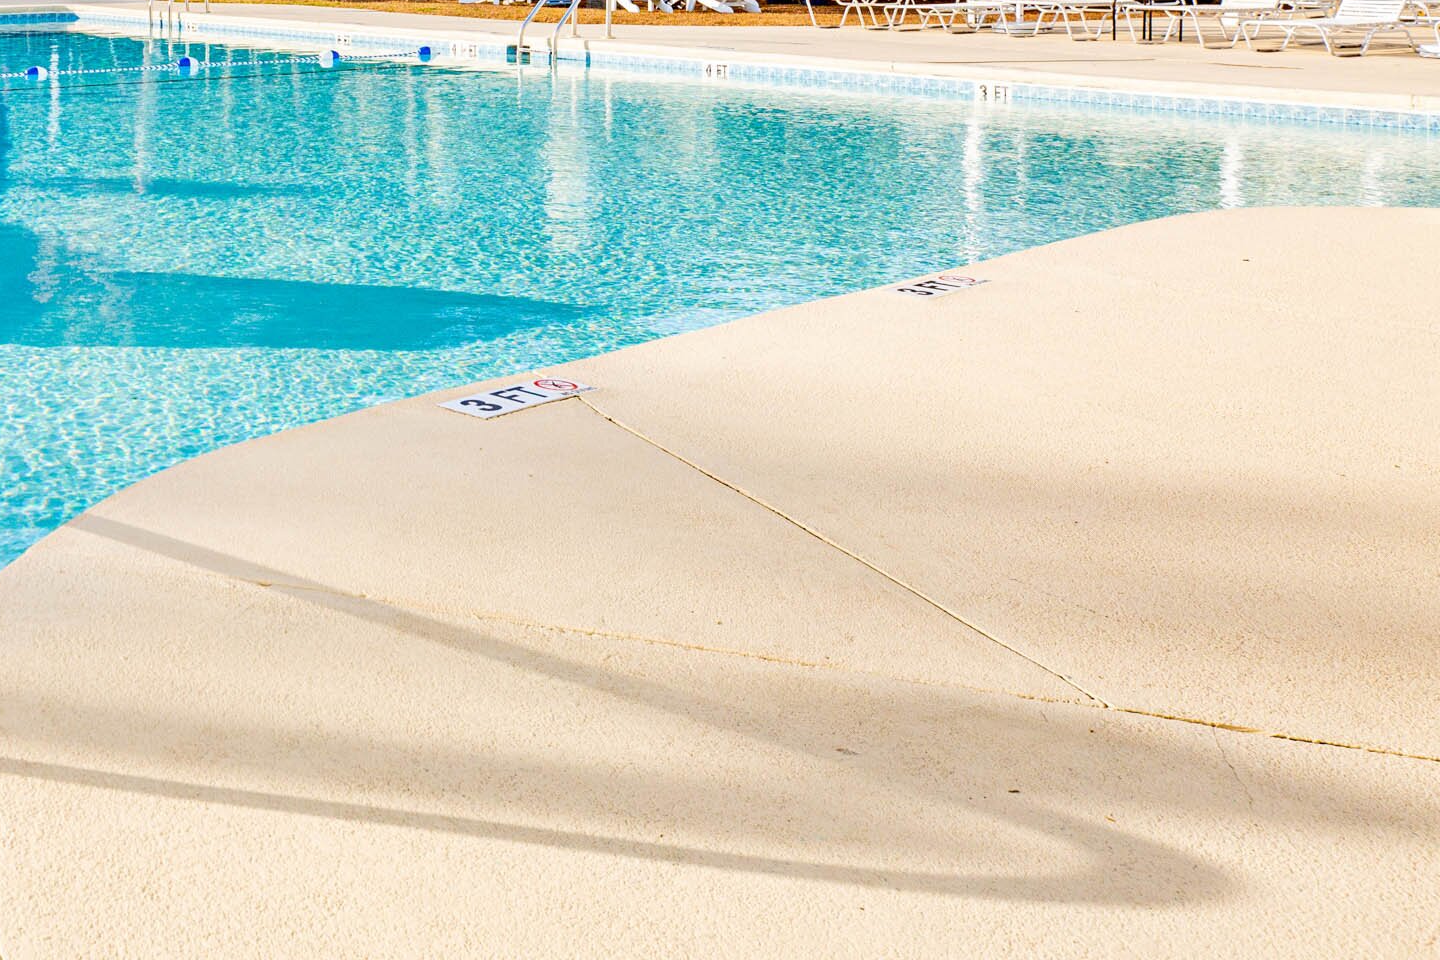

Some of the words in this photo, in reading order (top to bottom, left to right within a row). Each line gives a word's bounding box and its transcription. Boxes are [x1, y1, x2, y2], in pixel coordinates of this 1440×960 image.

[897, 287, 934, 296] 3
[913, 280, 961, 292] FT
[459, 398, 503, 413] 3
[489, 386, 549, 405] FT
